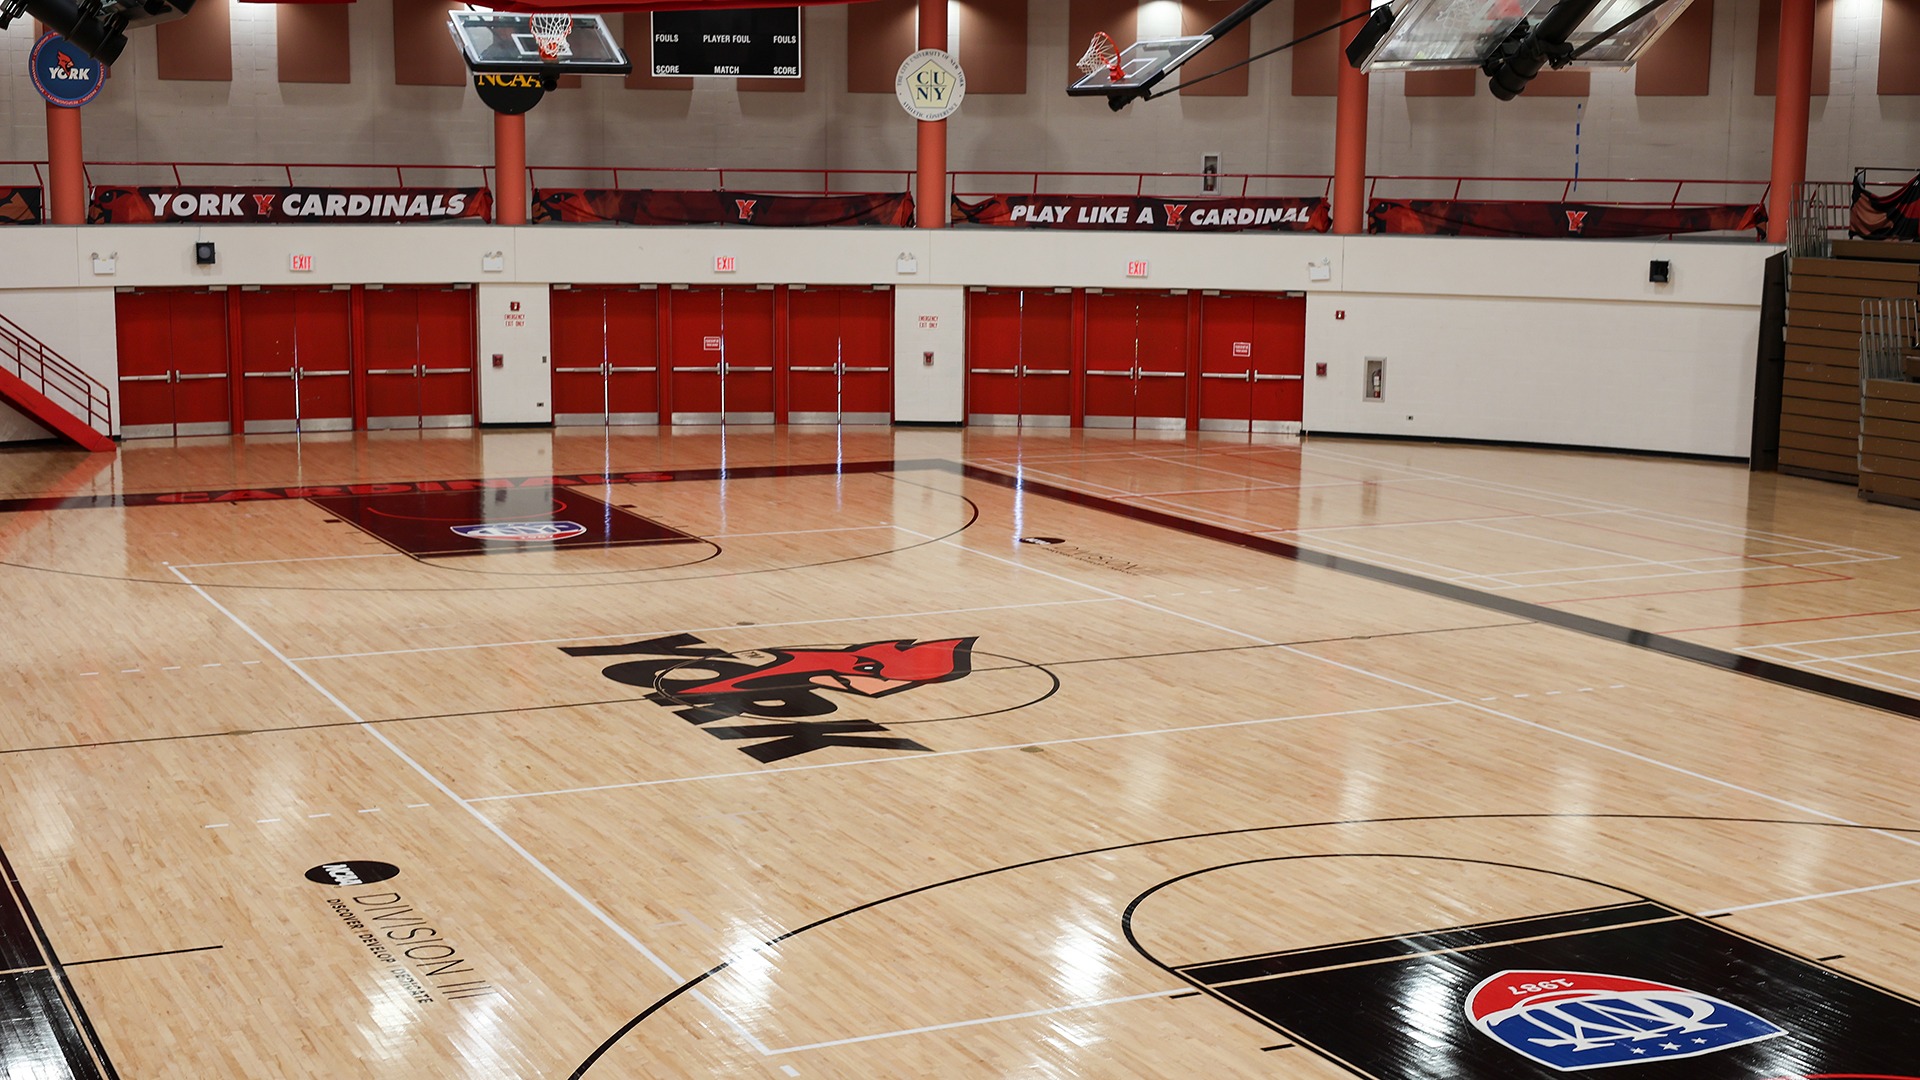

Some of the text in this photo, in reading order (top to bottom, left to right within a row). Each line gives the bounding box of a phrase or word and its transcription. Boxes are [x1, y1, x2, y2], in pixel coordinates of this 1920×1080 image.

[655, 34, 679, 43] FOULS
[703, 35, 751, 43] PLAYER FOUL
[773, 35, 797, 44] FOULS
[656, 65, 680, 74] SCORE
[901, 62, 910, 74] CITY
[909, 51, 941, 62] UNIVERSITY
[950, 59, 959, 70] NEW
[48, 67, 90, 80] YORK
[714, 66, 740, 74] MATCH
[773, 66, 797, 75] SCORE
[478, 73, 542, 88] NCAA
[925, 102, 958, 119] CONFERENCE
[149, 193, 246, 217] YORK
[282, 193, 468, 217] CARDINALS
[1010, 205, 1072, 223] PLAY
[1077, 206, 1130, 224] LIKE
[1136, 207, 1154, 225] A
[1189, 206, 1311, 226] CARDINAL
[293, 256, 313, 270] EXIT
[716, 257, 735, 271] EXIT
[1128, 261, 1147, 275] EXIT
[155, 472, 675, 503] CARDINALS
[557, 633, 936, 764] YORK
[326, 898, 364, 930] DISCOVER
[358, 933, 396, 963] DEVELOP
[352, 892, 474, 976] DIVISION
[1507, 977, 1575, 996] 1987
